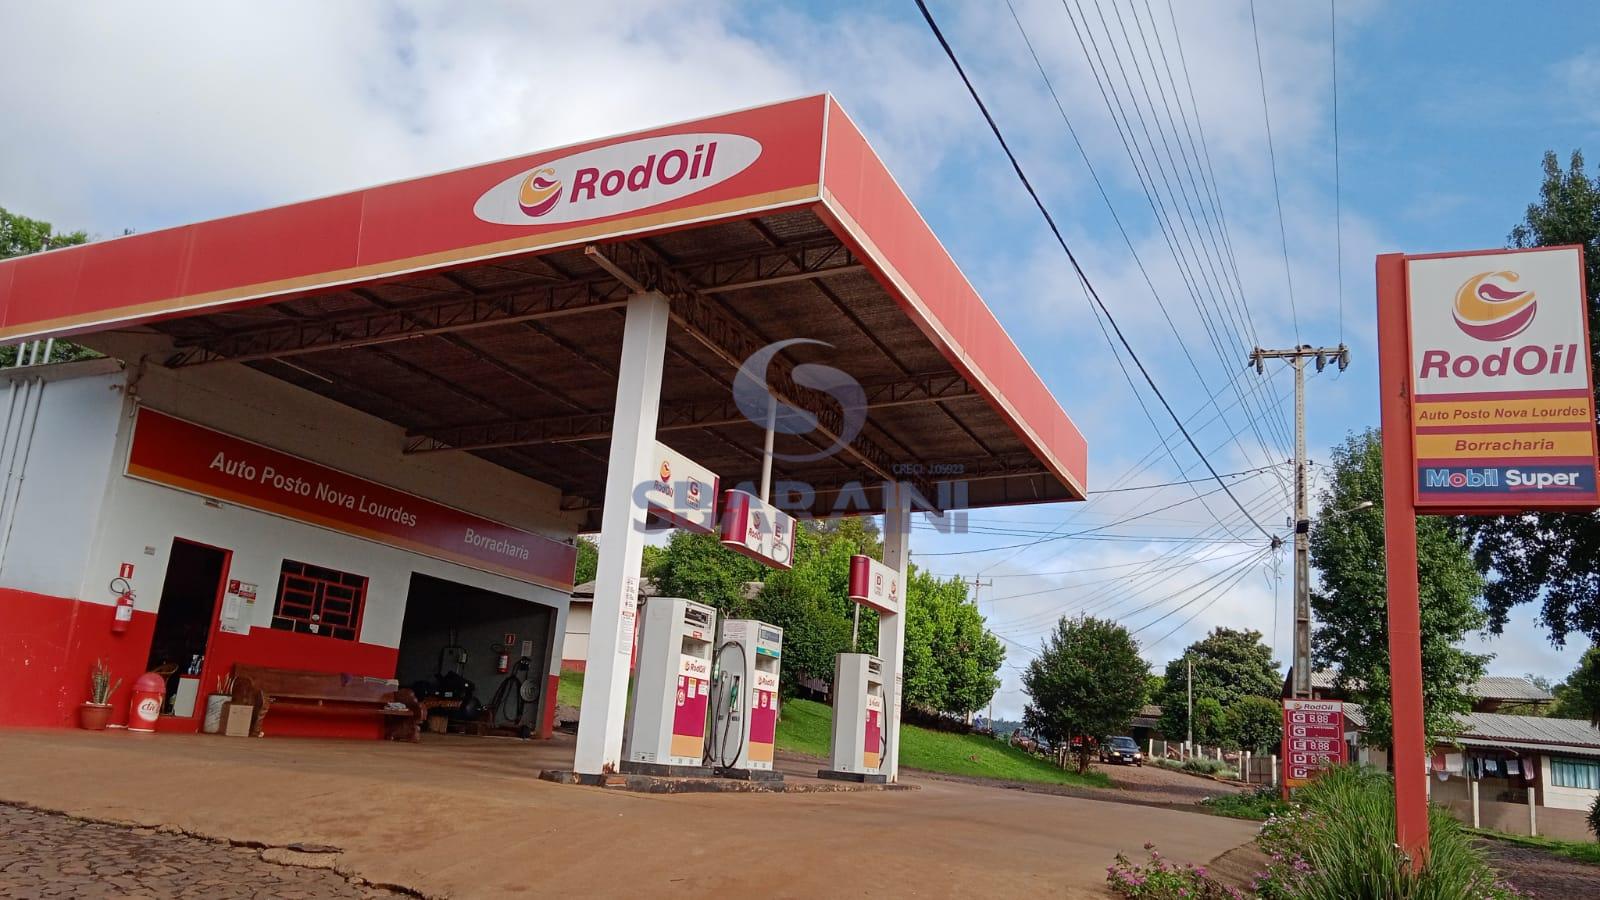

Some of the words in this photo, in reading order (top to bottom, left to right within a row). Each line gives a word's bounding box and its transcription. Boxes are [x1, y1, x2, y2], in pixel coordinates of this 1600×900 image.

[570, 142, 717, 203] RodOil
[1420, 344, 1578, 379] RodOil
[1419, 410, 1449, 421] Auto
[1453, 408, 1490, 420] Posto
[1494, 407, 1528, 418] Nova
[1532, 405, 1587, 417] Lourdes
[1455, 438, 1554, 451] Borracharia
[690, 481, 699, 496] G
[1426, 468, 1499, 488] Mobil
[1505, 469, 1580, 490] Super
[209, 451, 256, 481] Auto
[260, 466, 311, 496] Posto
[314, 482, 355, 511] Nova
[358, 495, 417, 527] Lourdes
[774, 526, 782, 539] E
[463, 527, 530, 560] Borracharia
[1304, 703, 1333, 711] RodOil
